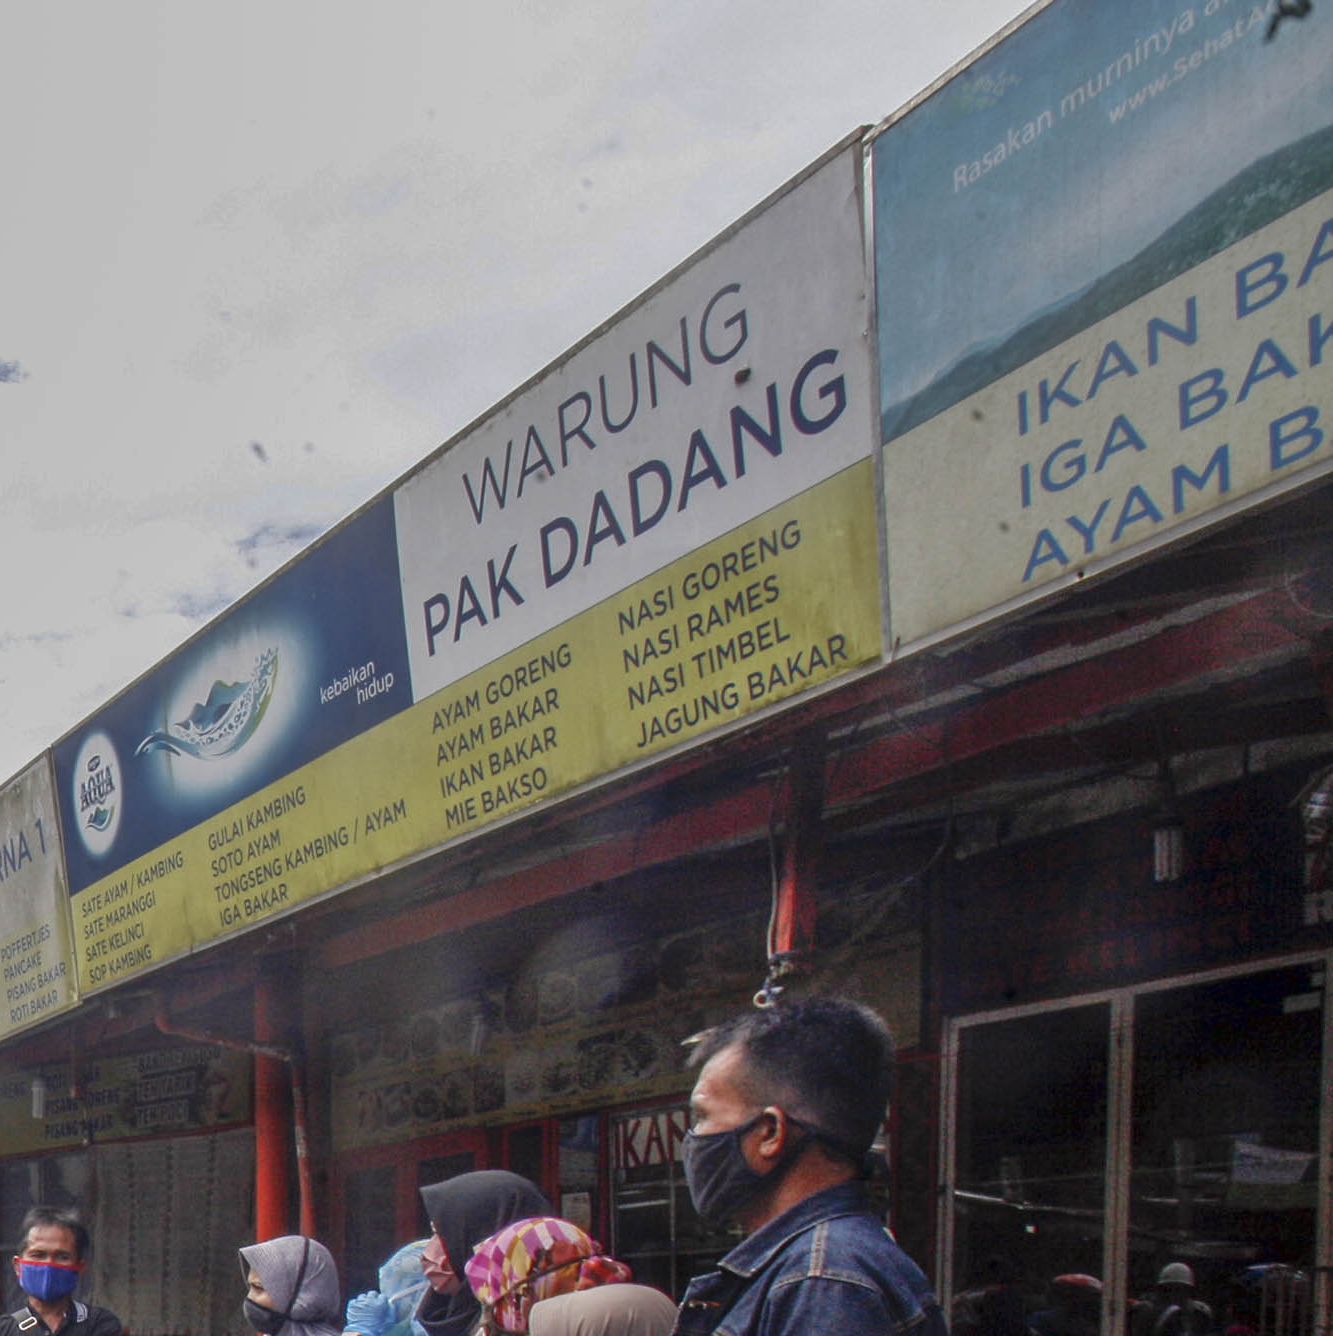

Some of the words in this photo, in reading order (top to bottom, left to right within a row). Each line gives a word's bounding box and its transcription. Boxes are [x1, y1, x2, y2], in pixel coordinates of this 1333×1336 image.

[953, 108, 1053, 192] Rasakan
[1060, 8, 1196, 118] murninya
[1018, 295, 1198, 436] IKAN
[462, 283, 749, 525] WARUNG
[1020, 413, 1147, 508] IGA
[423, 543, 525, 657] PAK
[539, 348, 847, 589] DADANG
[1021, 443, 1230, 583] AYAM
[618, 585, 675, 635] NASI
[683, 520, 801, 600] GORENG
[623, 624, 679, 673] NASI
[687, 575, 779, 641] RAMES
[320, 661, 375, 704] kebaikan
[356, 671, 395, 705] hidup
[433, 690, 480, 735] AYAM
[485, 643, 572, 705] GORENG
[628, 663, 685, 710] NASI
[691, 617, 791, 679] TIMBEL
[637, 682, 739, 748] JAGUNG
[747, 633, 848, 701] BAKAR
[437, 723, 485, 767] AYAM
[489, 688, 560, 740] BAKAR
[440, 760, 484, 798] IKAN
[488, 725, 558, 777] BAKAR
[208, 816, 244, 851] GULAI
[246, 786, 306, 832] KAMBING
[445, 797, 478, 830] MIE
[482, 767, 548, 814] BAKSO
[35, 818, 47, 855] 1
[211, 848, 243, 878] SOTO
[247, 828, 282, 862] AYAM
[214, 858, 282, 903] TONGSENG
[284, 826, 349, 872] KAMBING
[365, 797, 407, 836] AYAM
[81, 895, 102, 918] SATE
[103, 879, 129, 908] AYAM
[136, 851, 184, 889] KAMBING
[84, 917, 105, 940] SATE
[106, 891, 157, 928] MARANGGI
[219, 904, 241, 927] IGA
[244, 883, 288, 917] BAKAR
[0, 924, 51, 962] POFFERTJES
[3, 951, 42, 980] PANCAKE
[86, 941, 108, 963] SATE
[109, 922, 145, 952] KELINCI
[89, 963, 107, 984] SOP
[109, 943, 152, 976] KAMBING
[7, 977, 36, 1003] PISANG
[37, 961, 67, 988] BAKAR
[10, 1003, 30, 1023] ROTI
[30, 989, 58, 1015] BAKAR
